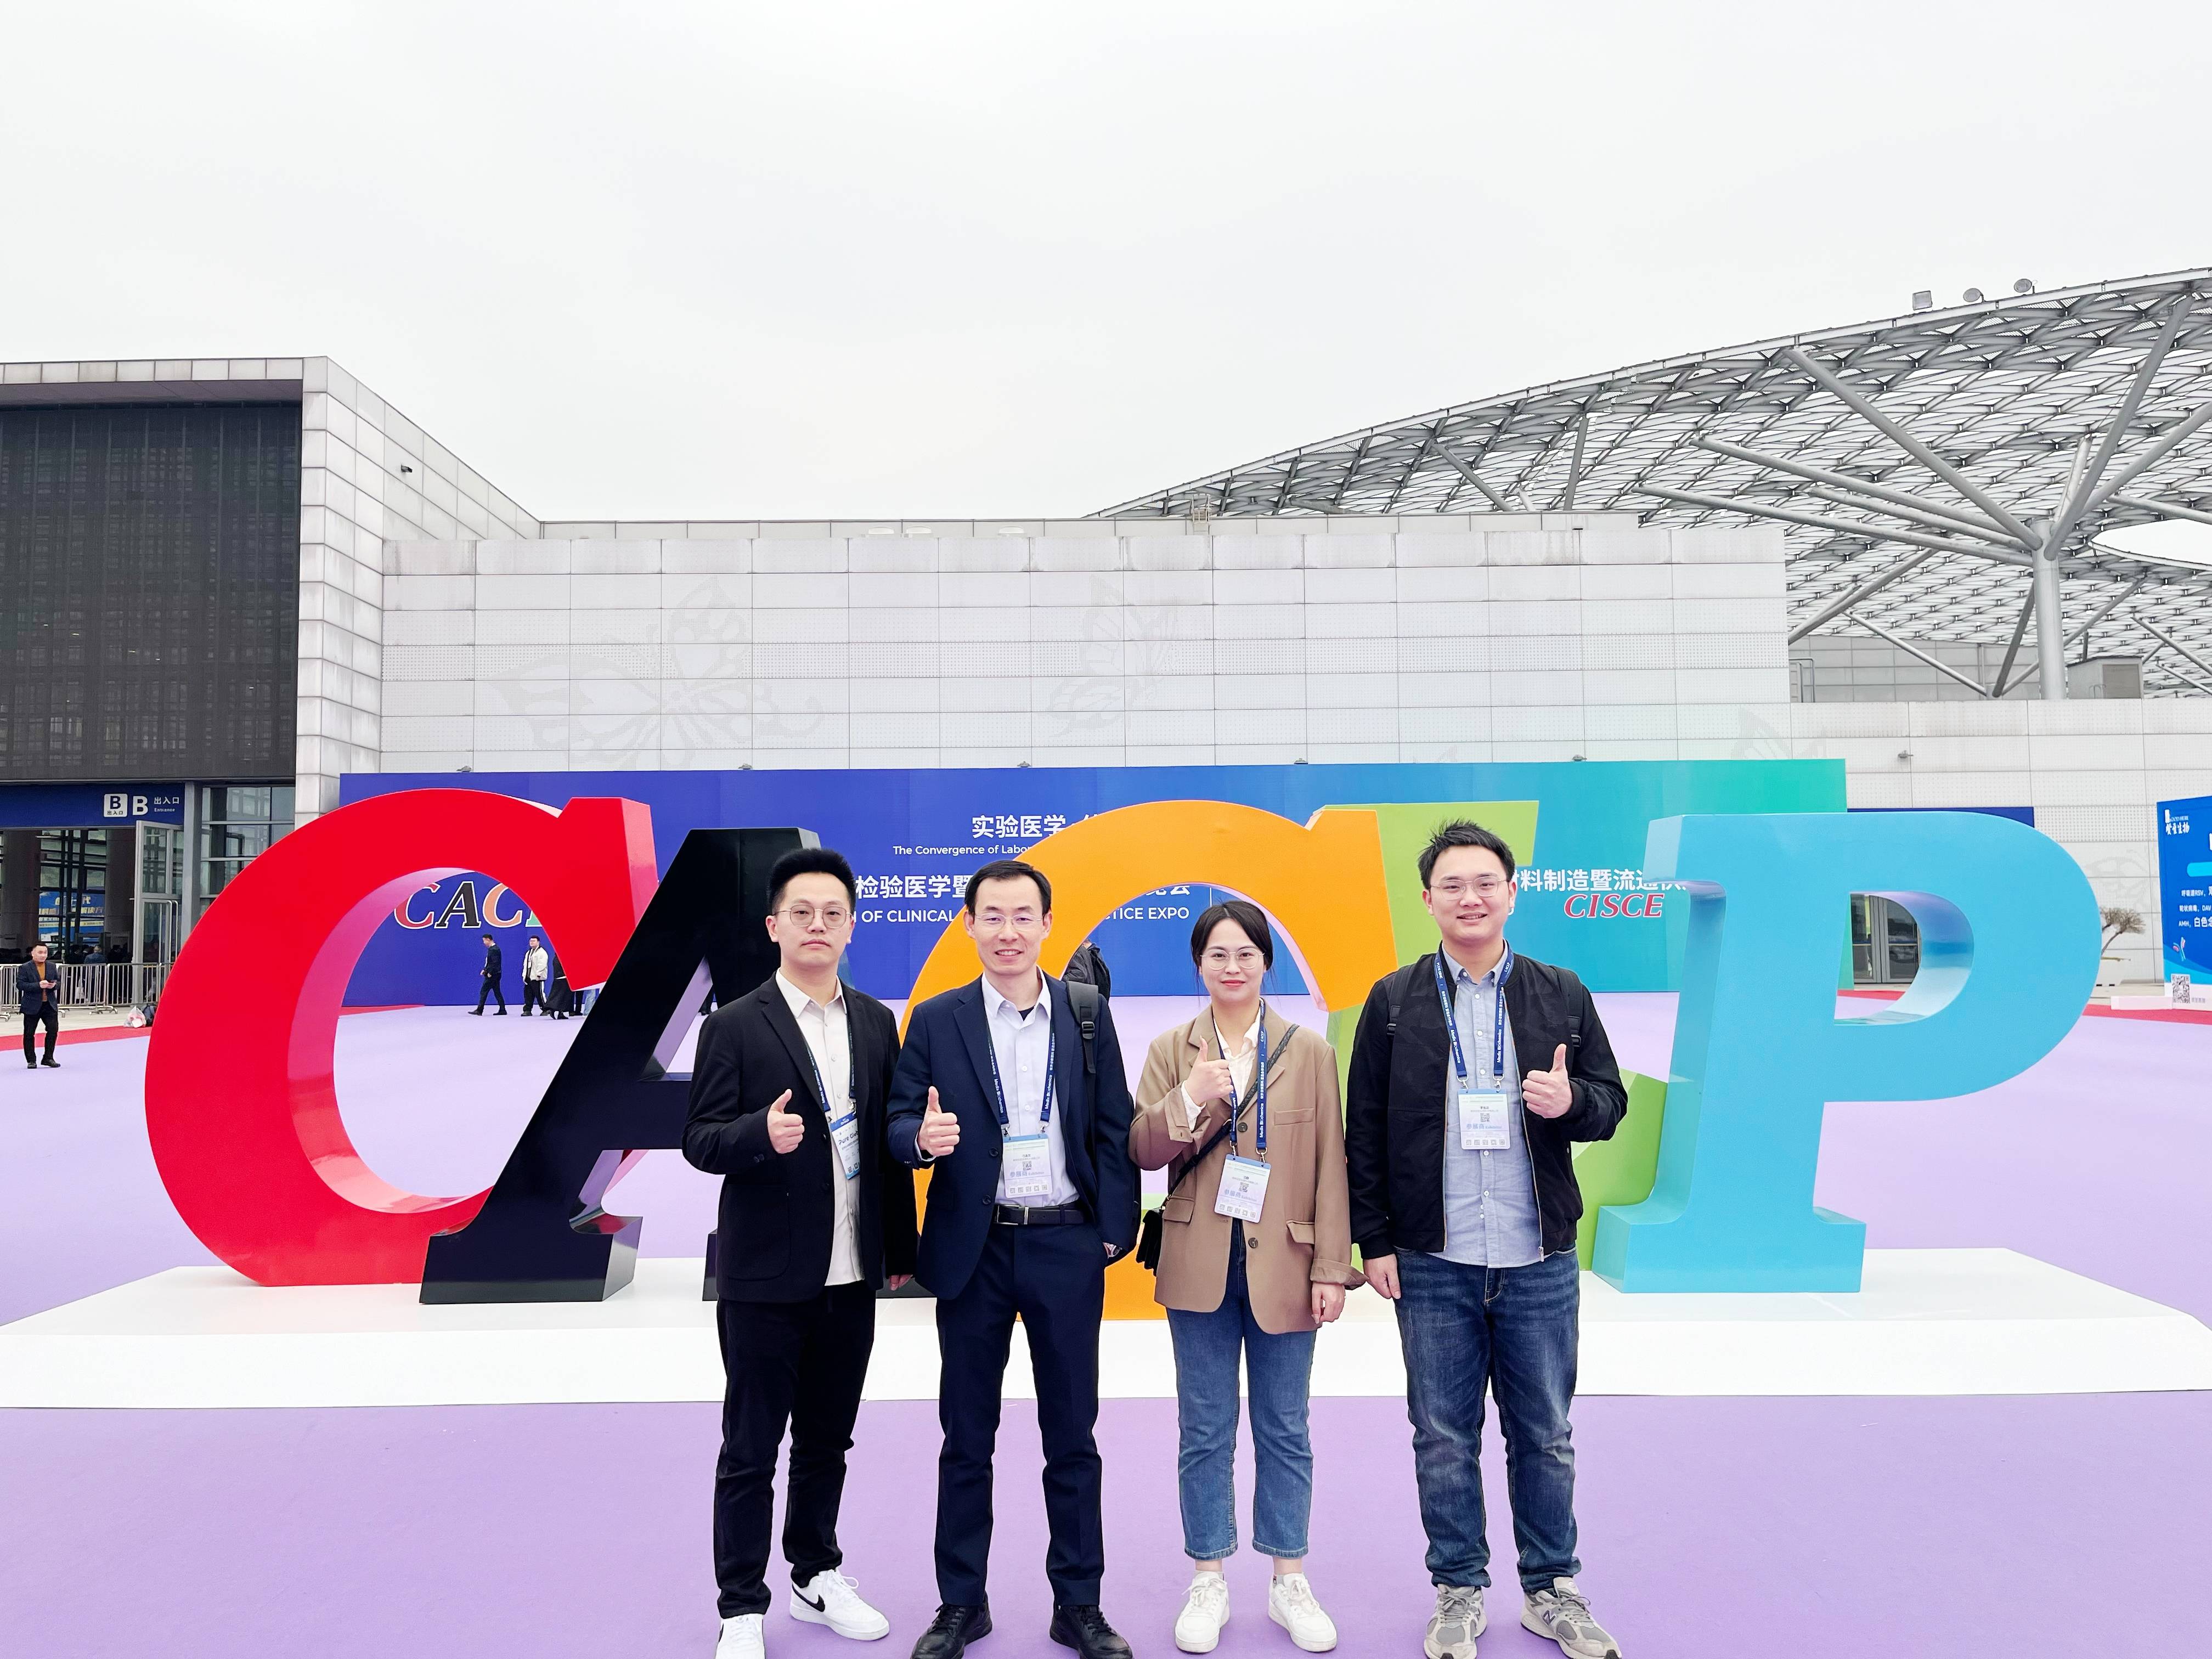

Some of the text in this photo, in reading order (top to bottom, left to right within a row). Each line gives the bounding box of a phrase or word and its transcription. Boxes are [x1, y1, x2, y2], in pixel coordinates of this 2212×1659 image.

[110, 796, 121, 809] B
[132, 796, 149, 816] B
[154, 797, 179, 805] 出入口
[893, 845, 912, 855] The
[915, 845, 985, 856] Convergence
[988, 845, 999, 854] of
[1564, 893, 1664, 918] CISCE
[861, 910, 883, 923] OF
[887, 910, 954, 922] CLINICAL
[1105, 907, 1189, 920] TICE EXPO
